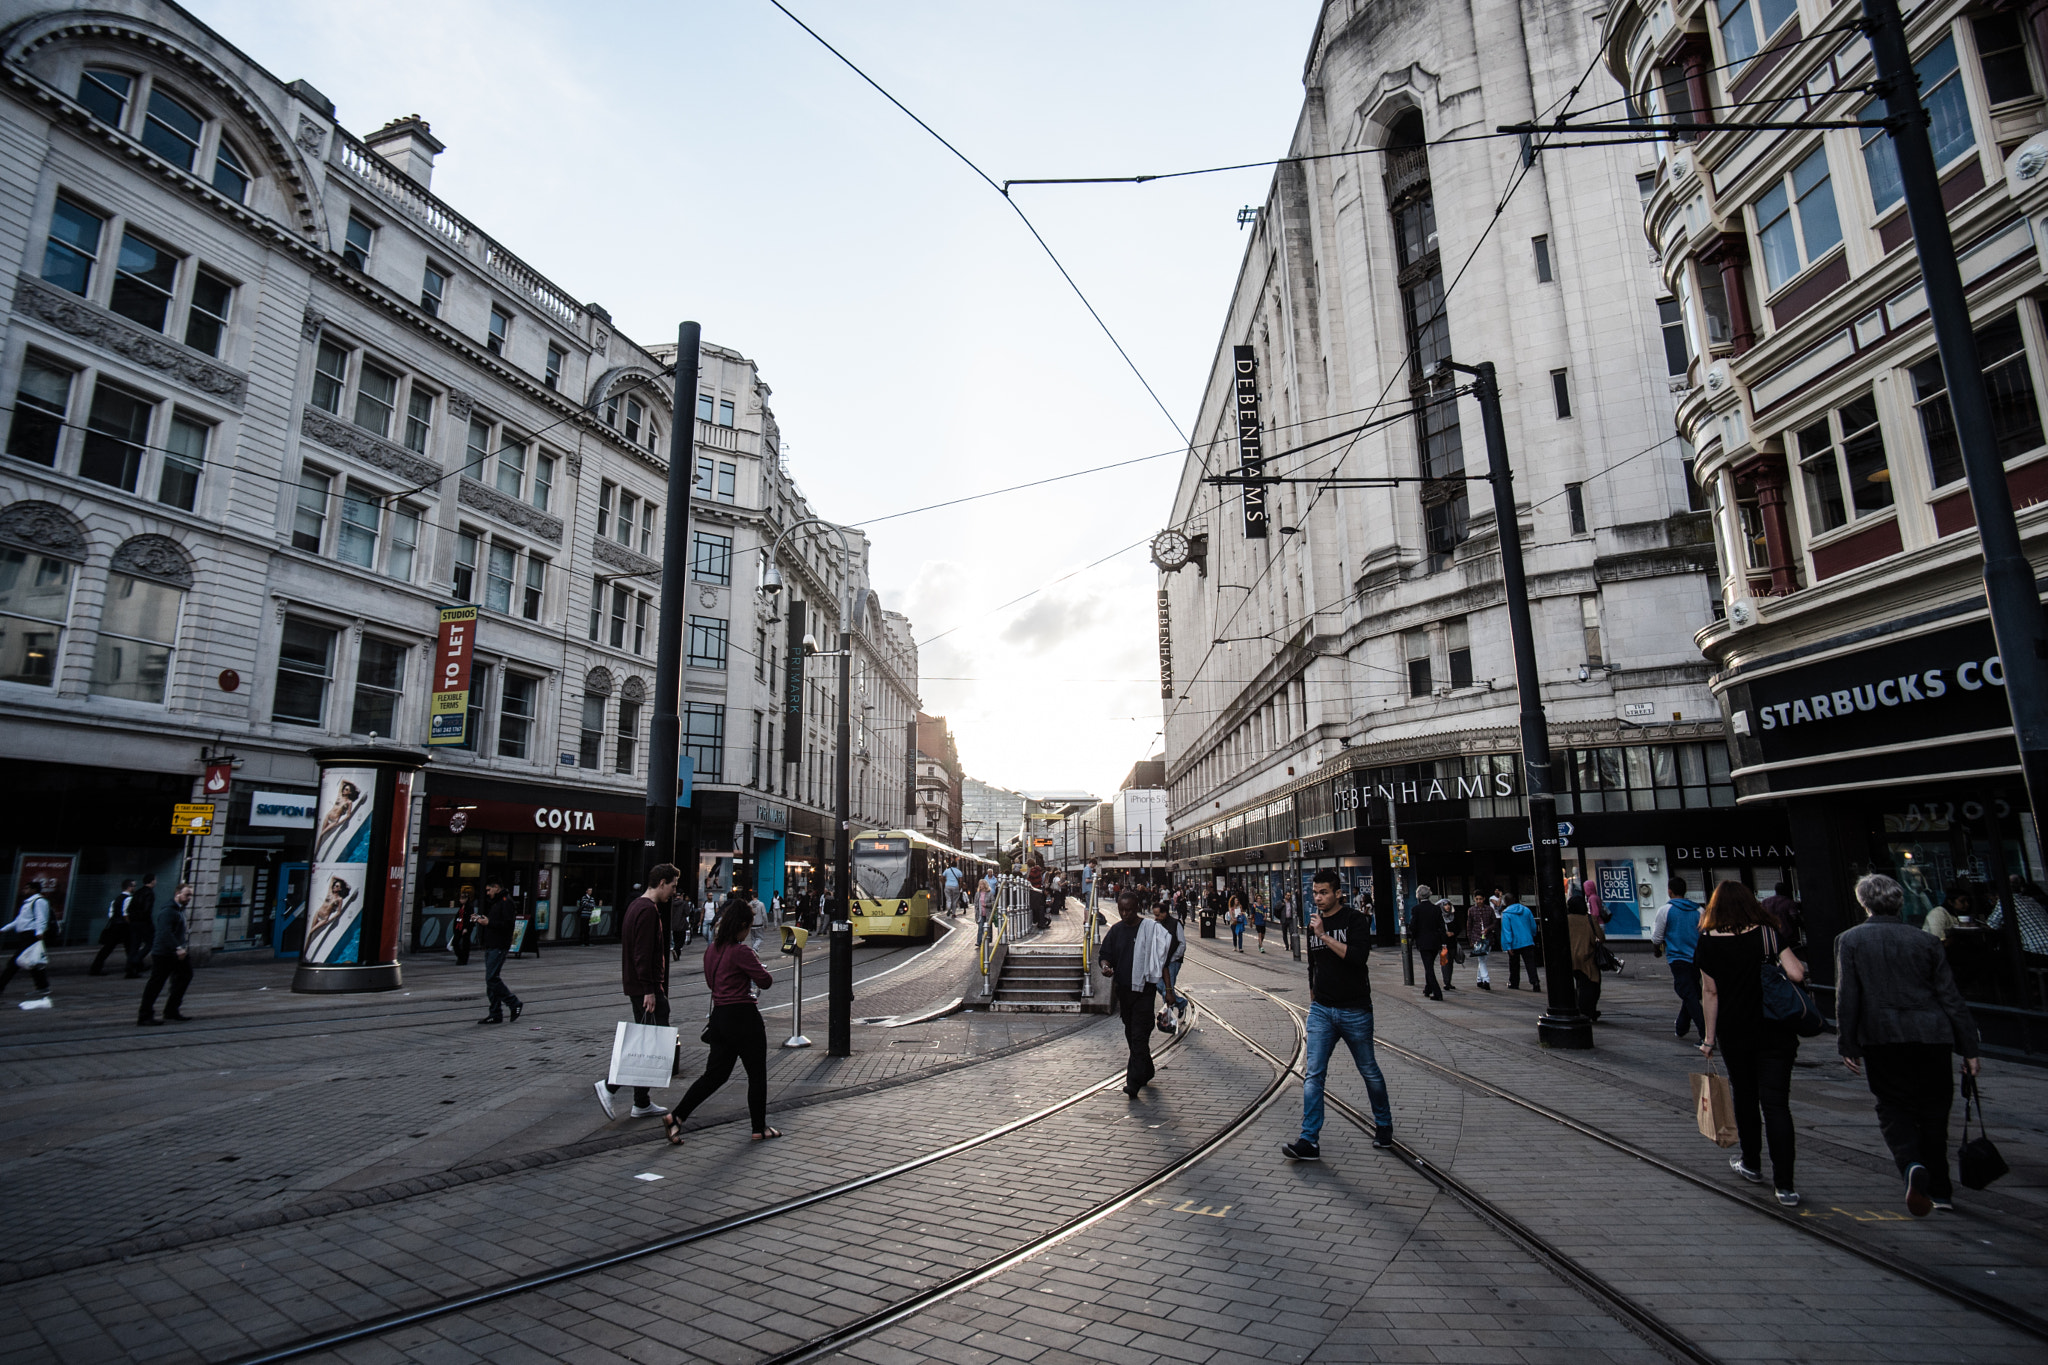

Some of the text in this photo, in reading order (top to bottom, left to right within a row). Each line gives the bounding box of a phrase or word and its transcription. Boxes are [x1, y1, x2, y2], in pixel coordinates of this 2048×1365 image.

[1236, 359, 1264, 523] DEBENHAMS
[442, 609, 475, 620] STUDIOS
[1158, 598, 1171, 691] DEBENHAMS
[444, 624, 464, 689] TO LET
[790, 647, 802, 713] PRIMARK
[437, 693, 462, 702] FLEXIBLE
[440, 701, 459, 710] TERMS
[1759, 669, 1946, 731] STARBUCKS
[1130, 795, 1155, 804] iPhone
[1333, 773, 1513, 813] DEBENHAMS
[257, 803, 304, 817] SKIPTON
[757, 805, 786, 825] PRIMARK
[535, 807, 596, 833] COSTA
[1603, 870, 1629, 881] BLUE
[1604, 880, 1629, 889] CROSS
[1604, 888, 1631, 899] SALE
